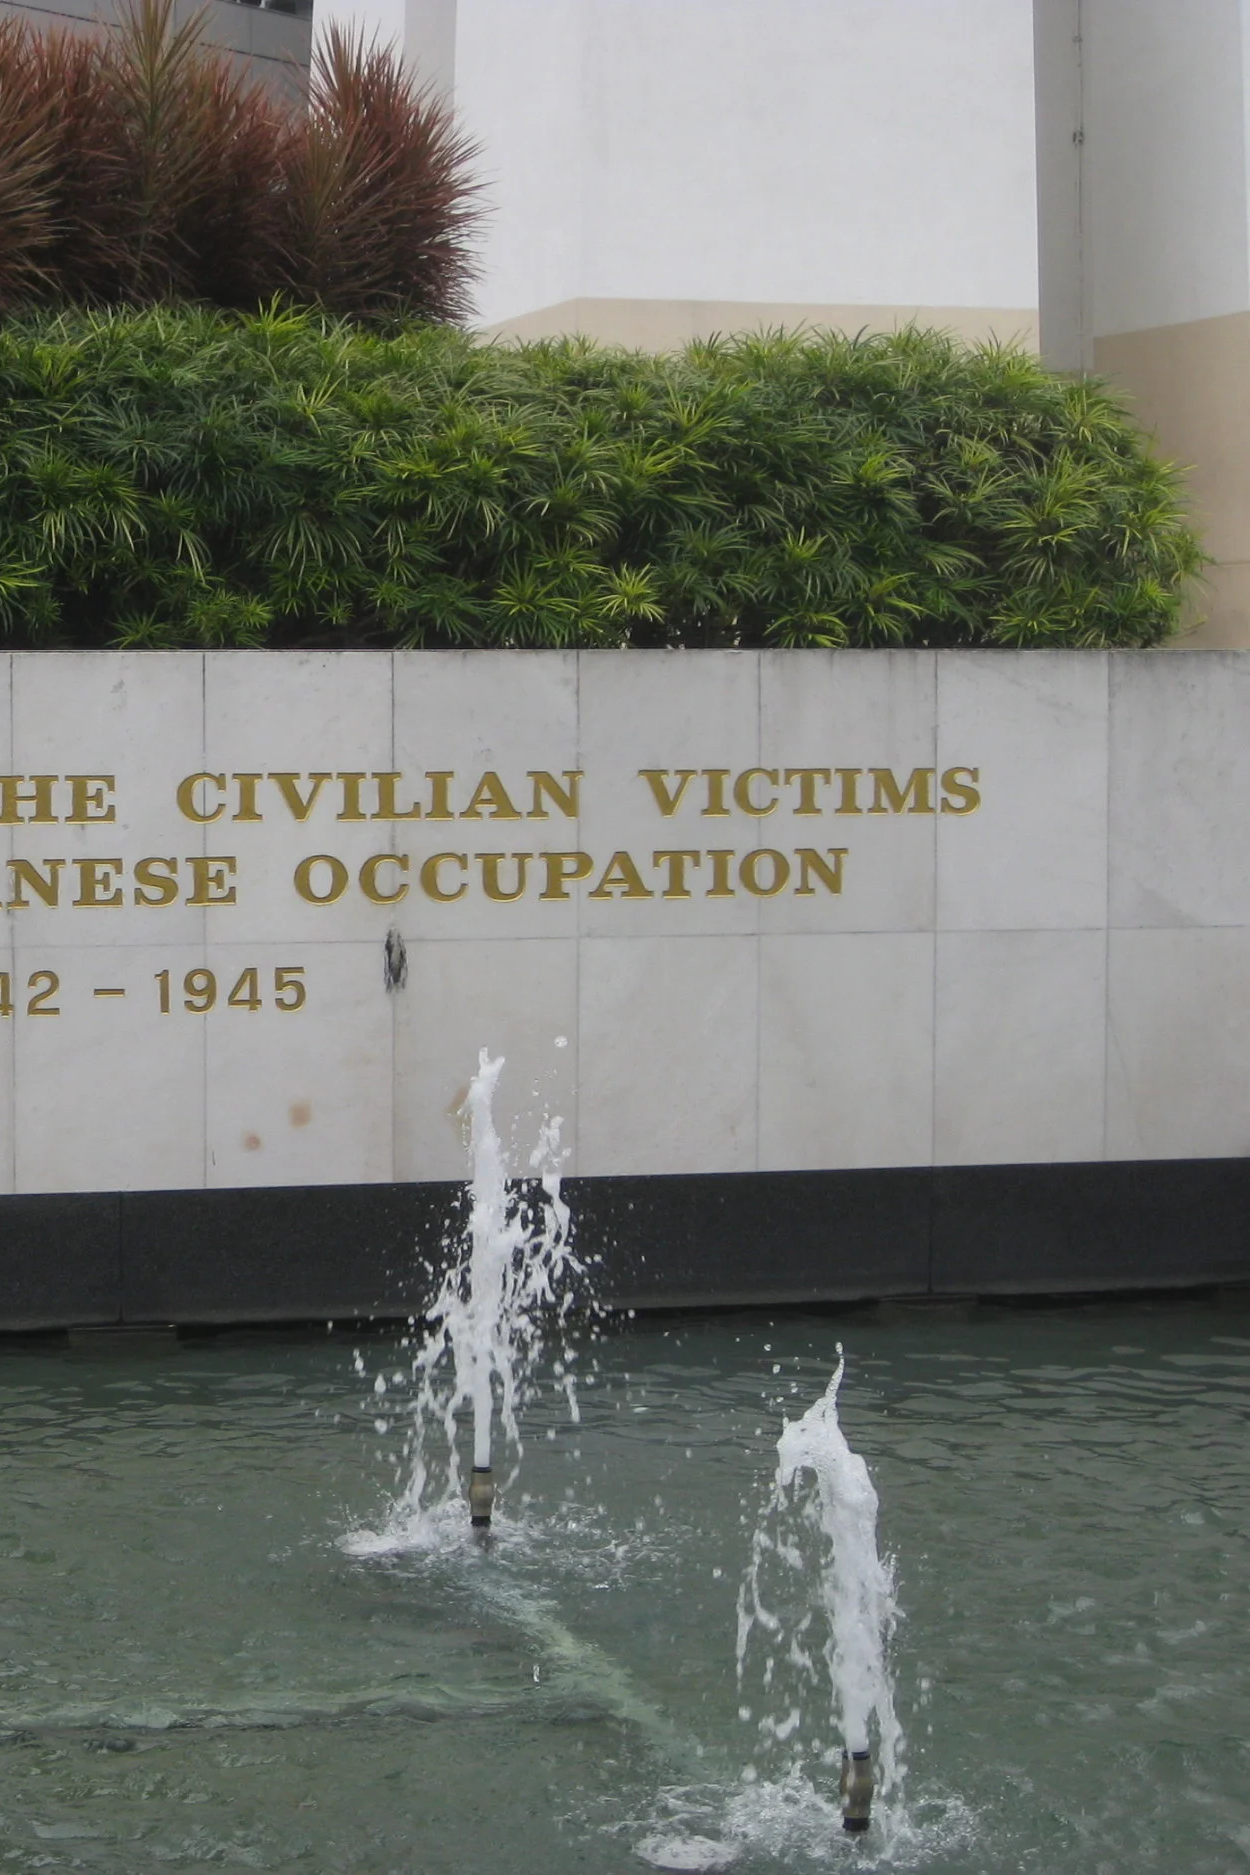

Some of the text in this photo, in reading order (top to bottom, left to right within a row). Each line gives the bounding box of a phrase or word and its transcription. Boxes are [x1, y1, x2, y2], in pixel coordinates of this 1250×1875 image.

[177, 770, 582, 822] CIVILIAN
[639, 767, 979, 816] VICTIMS
[295, 849, 848, 904] OCCUPATION
[154, 966, 305, 1013] 1945
